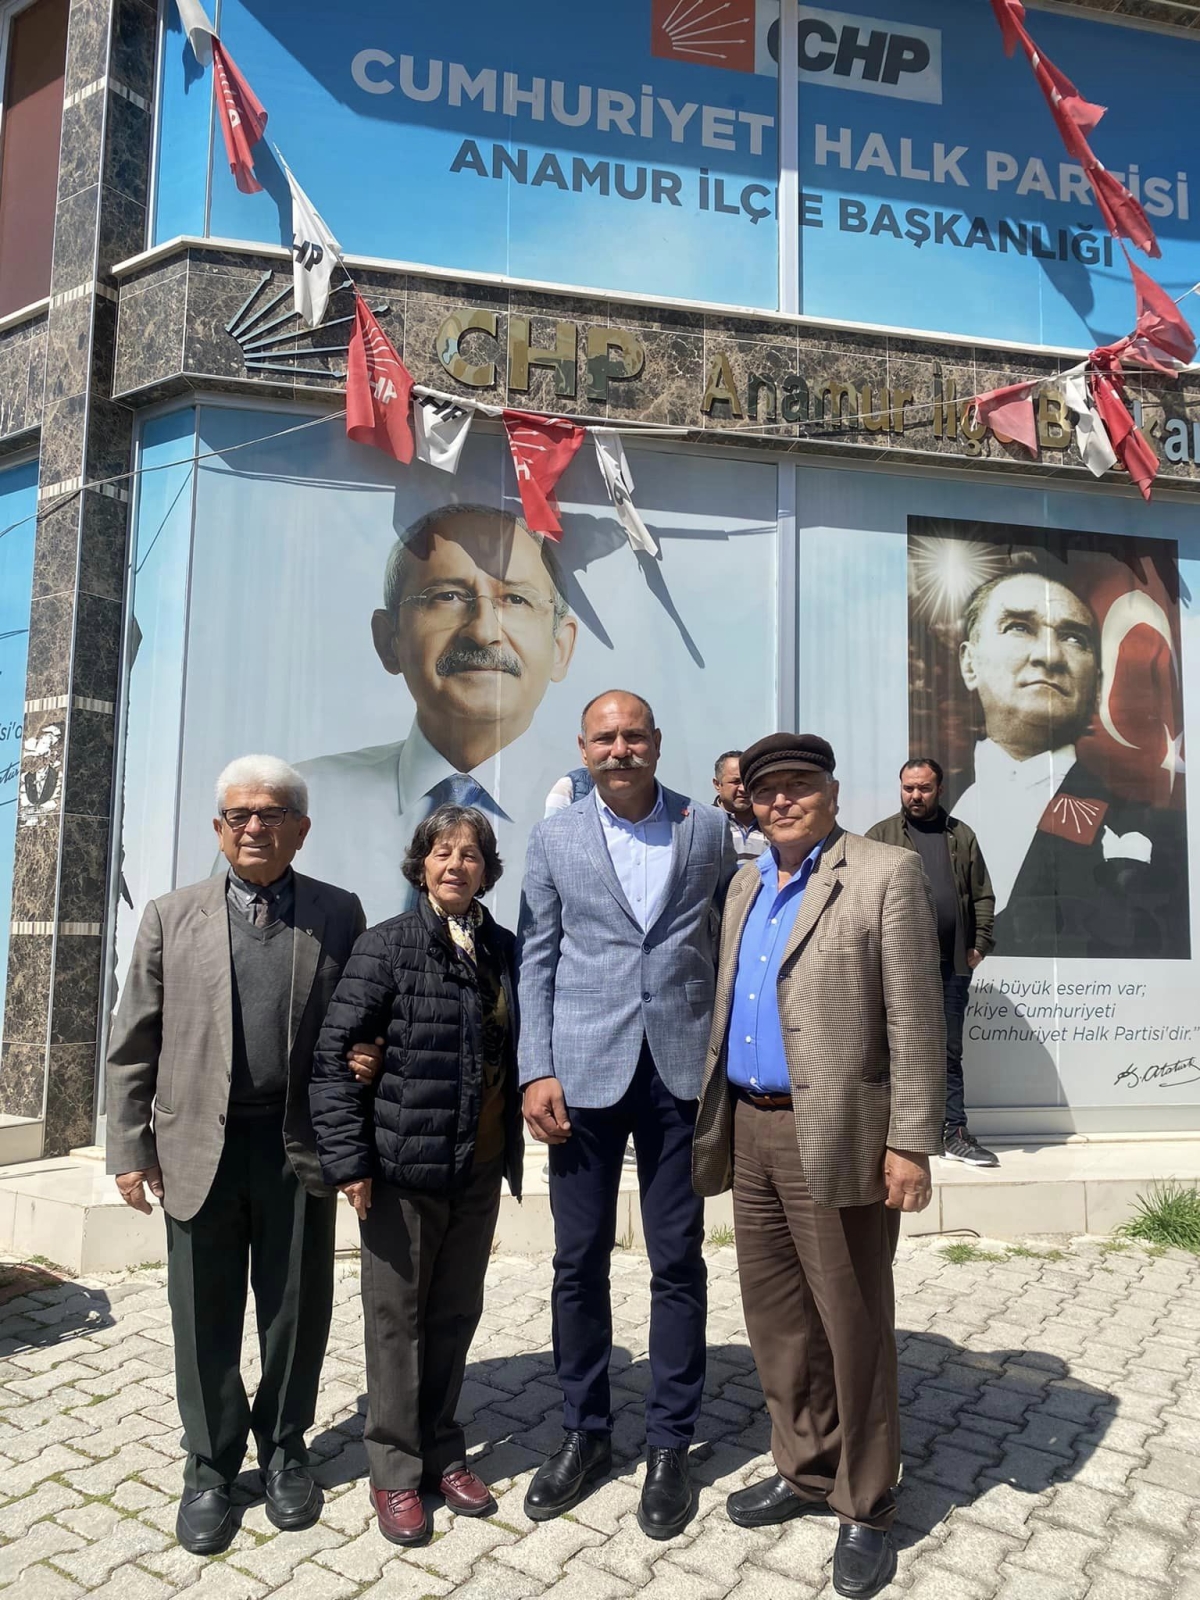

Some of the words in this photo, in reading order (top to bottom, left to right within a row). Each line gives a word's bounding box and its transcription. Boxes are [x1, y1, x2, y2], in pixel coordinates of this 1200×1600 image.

[767, 18, 931, 85] CHP
[351, 48, 774, 155] CUMHURİYET
[815, 124, 970, 188] HALK
[986, 150, 1189, 220] PARİSİ
[449, 139, 682, 207] ANAMUR
[699, 167, 823, 228] İLÇE
[839, 197, 1112, 268] BAŞKANLIĞI
[293, 233, 324, 272] HP
[436, 309, 645, 402] CHP
[702, 352, 913, 434] Anamur
[966, 1002, 1008, 1020] rkiye
[1014, 1002, 1117, 1021] Cumhuriyeti
[974, 979, 995, 994] iki
[999, 979, 1052, 998] büyük
[1057, 980, 1112, 996] eserim
[1118, 983, 1147, 998] var;
[968, 1025, 1068, 1044] Cumhuriyet
[1073, 1025, 1109, 1041] Halk
